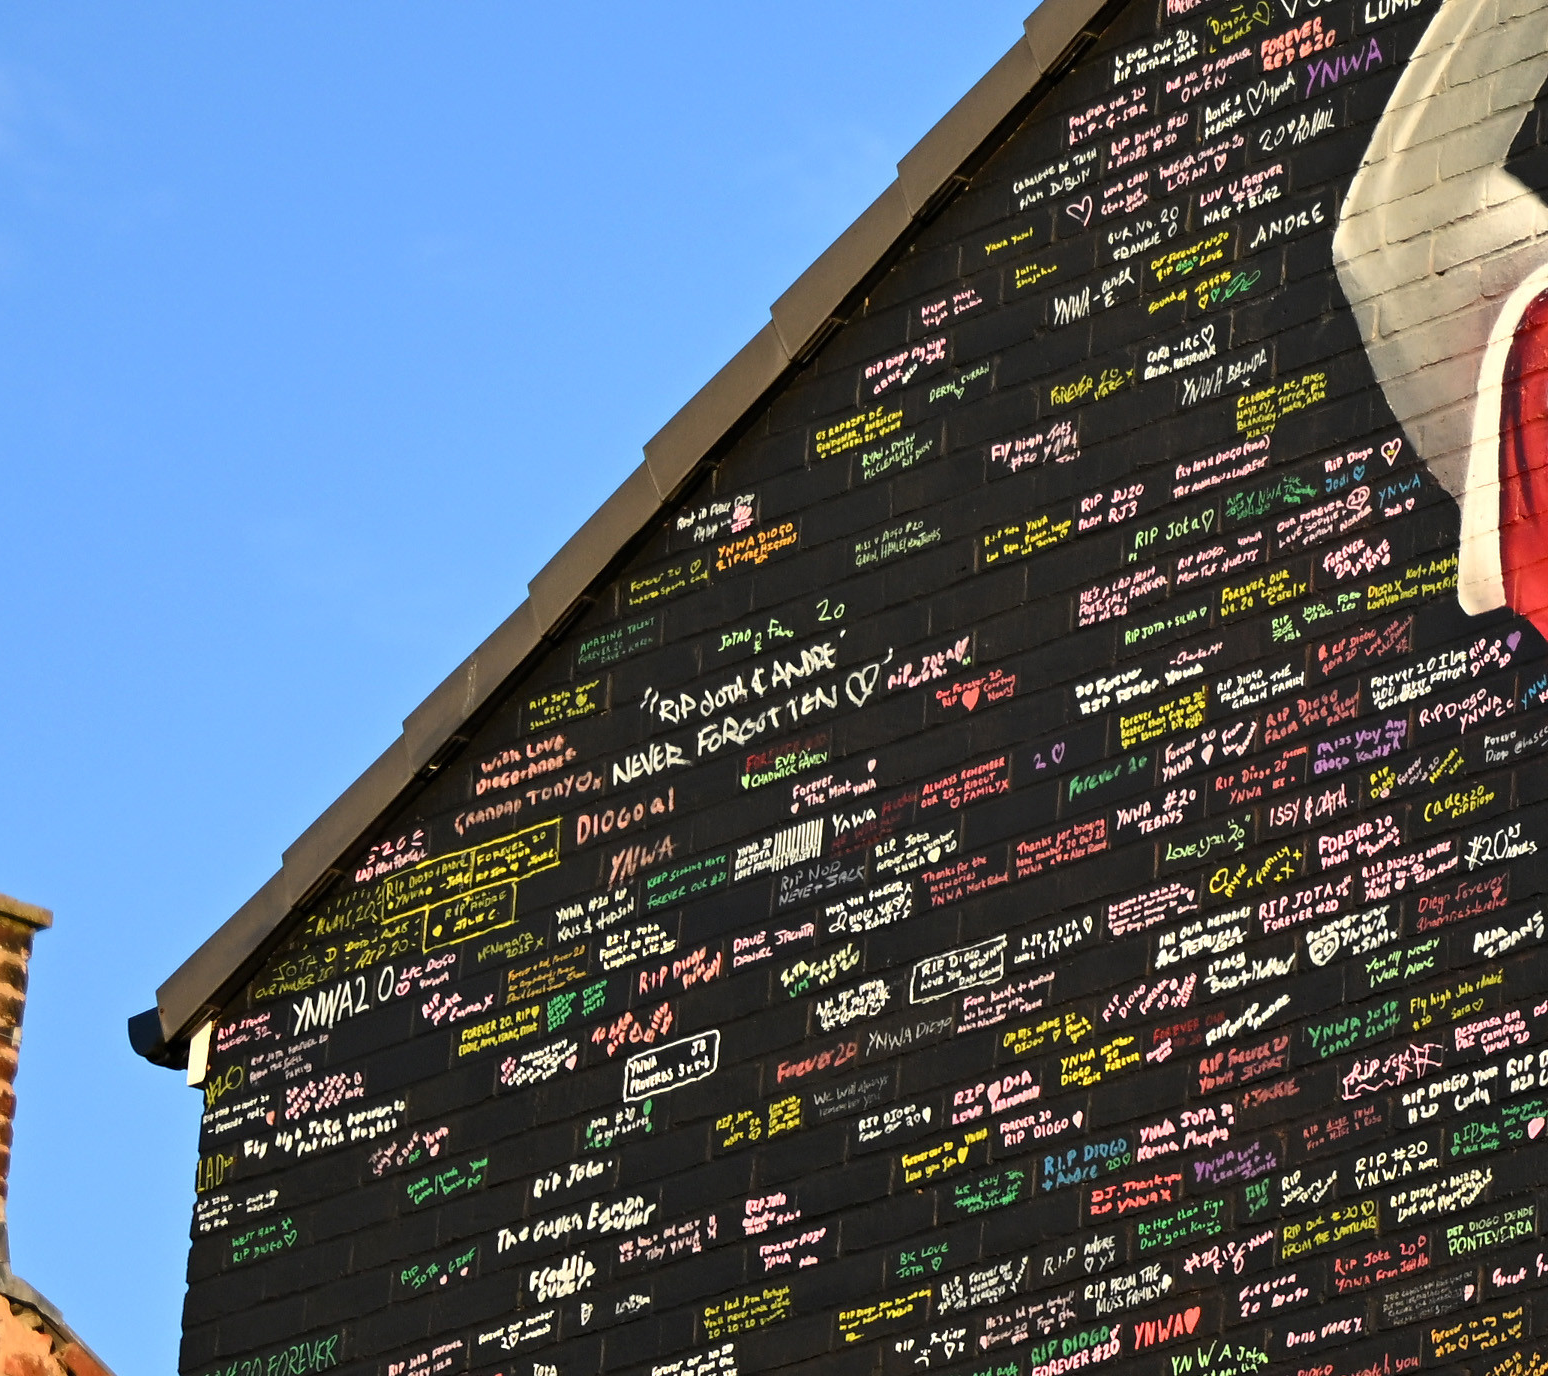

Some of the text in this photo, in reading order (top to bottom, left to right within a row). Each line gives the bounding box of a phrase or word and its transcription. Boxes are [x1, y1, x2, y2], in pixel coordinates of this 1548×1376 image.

[1307, 39, 1381, 94] YNWA
[613, 686, 838, 785] NEVER FORGOTTEN
[608, 836, 679, 890] YNWA
[1091, 1338, 1120, 1362] #20
[1135, 1315, 1185, 1350] YNWA
